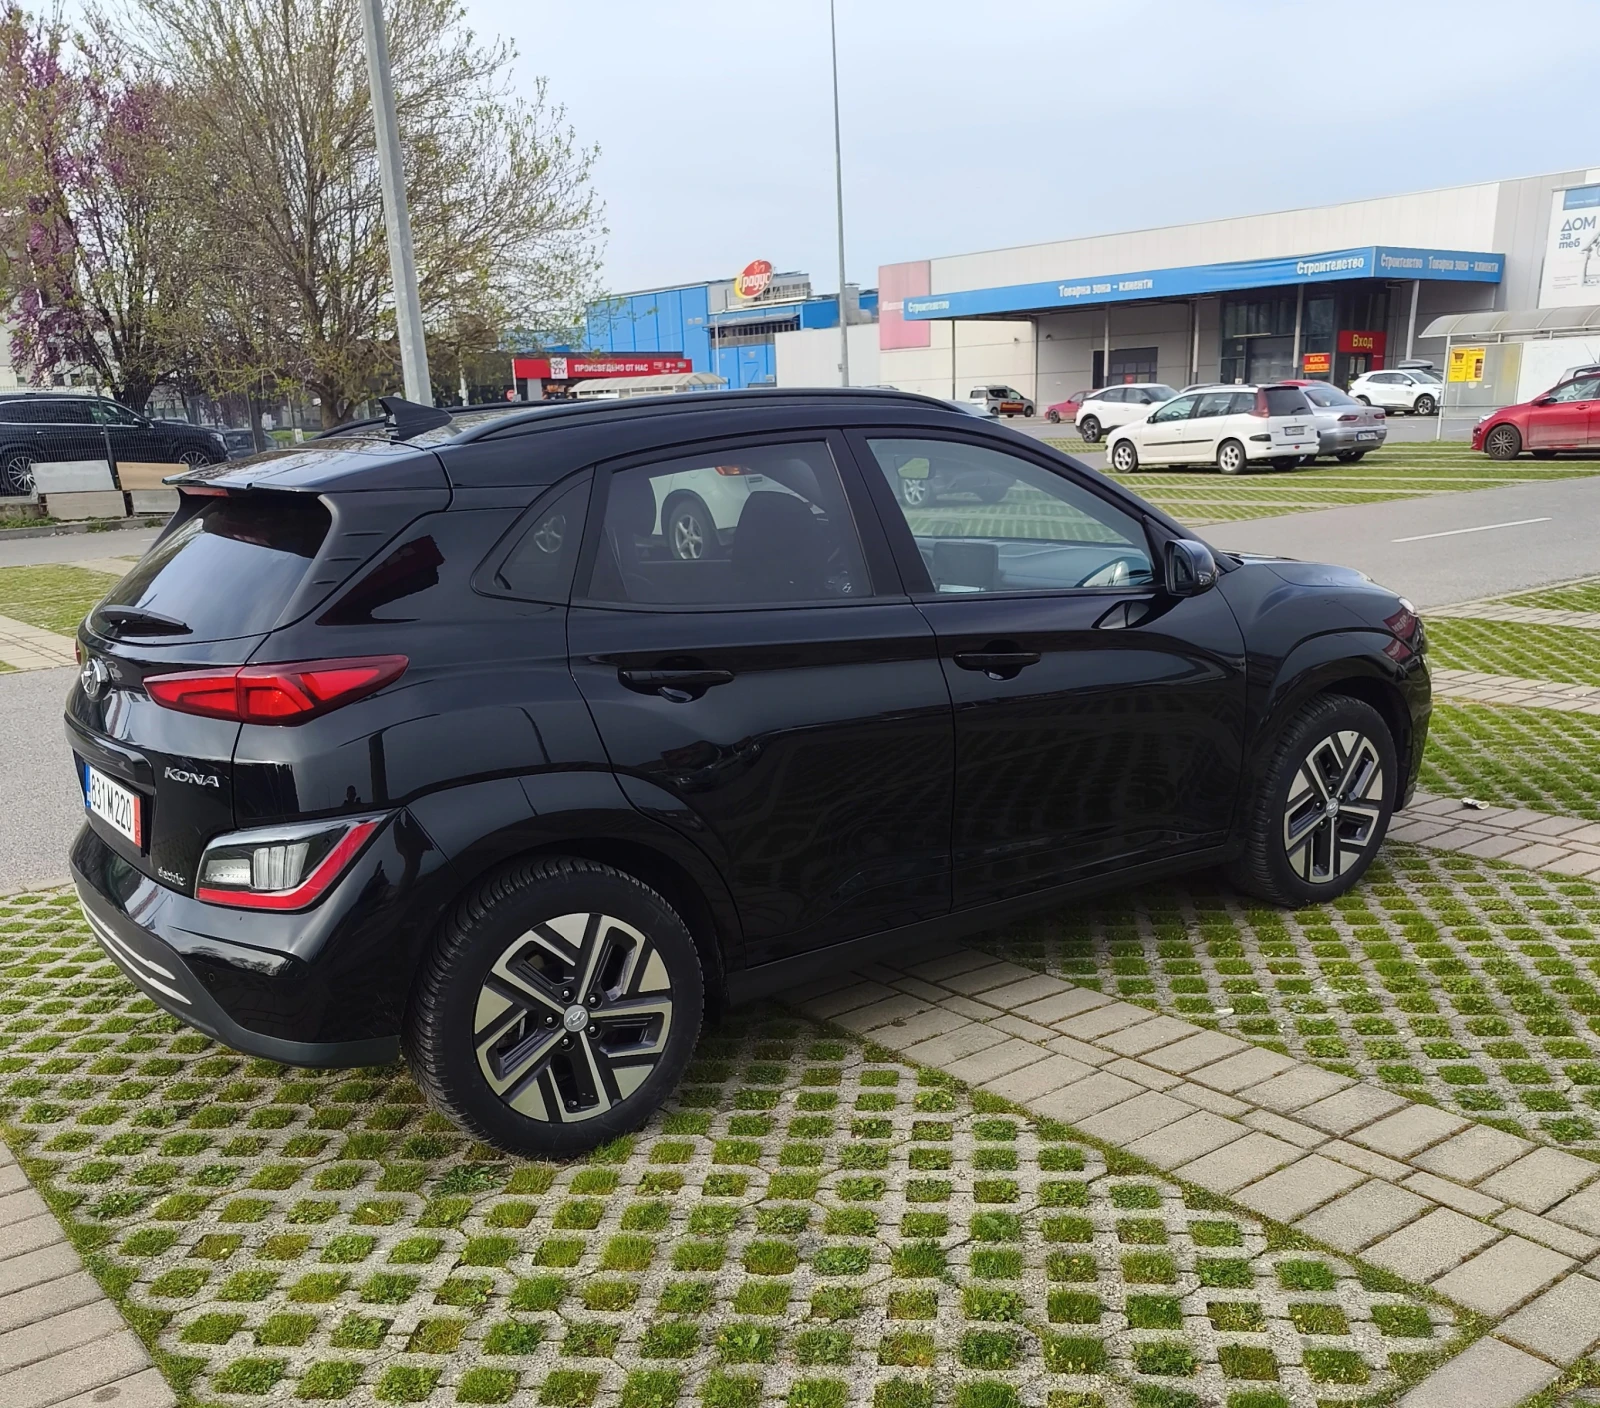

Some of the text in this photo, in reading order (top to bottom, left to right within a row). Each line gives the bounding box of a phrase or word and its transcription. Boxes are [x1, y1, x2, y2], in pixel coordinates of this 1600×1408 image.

[1561, 216, 1597, 232] ДОМ
[1559, 238, 1580, 249] теб
[1560, 233, 1571, 241] за
[1296, 257, 1365, 276] Строителство
[1381, 253, 1423, 270] Строителство
[1352, 334, 1374, 349] Вход
[635, 363, 649, 372] НАС
[164, 766, 220, 788] KONA
